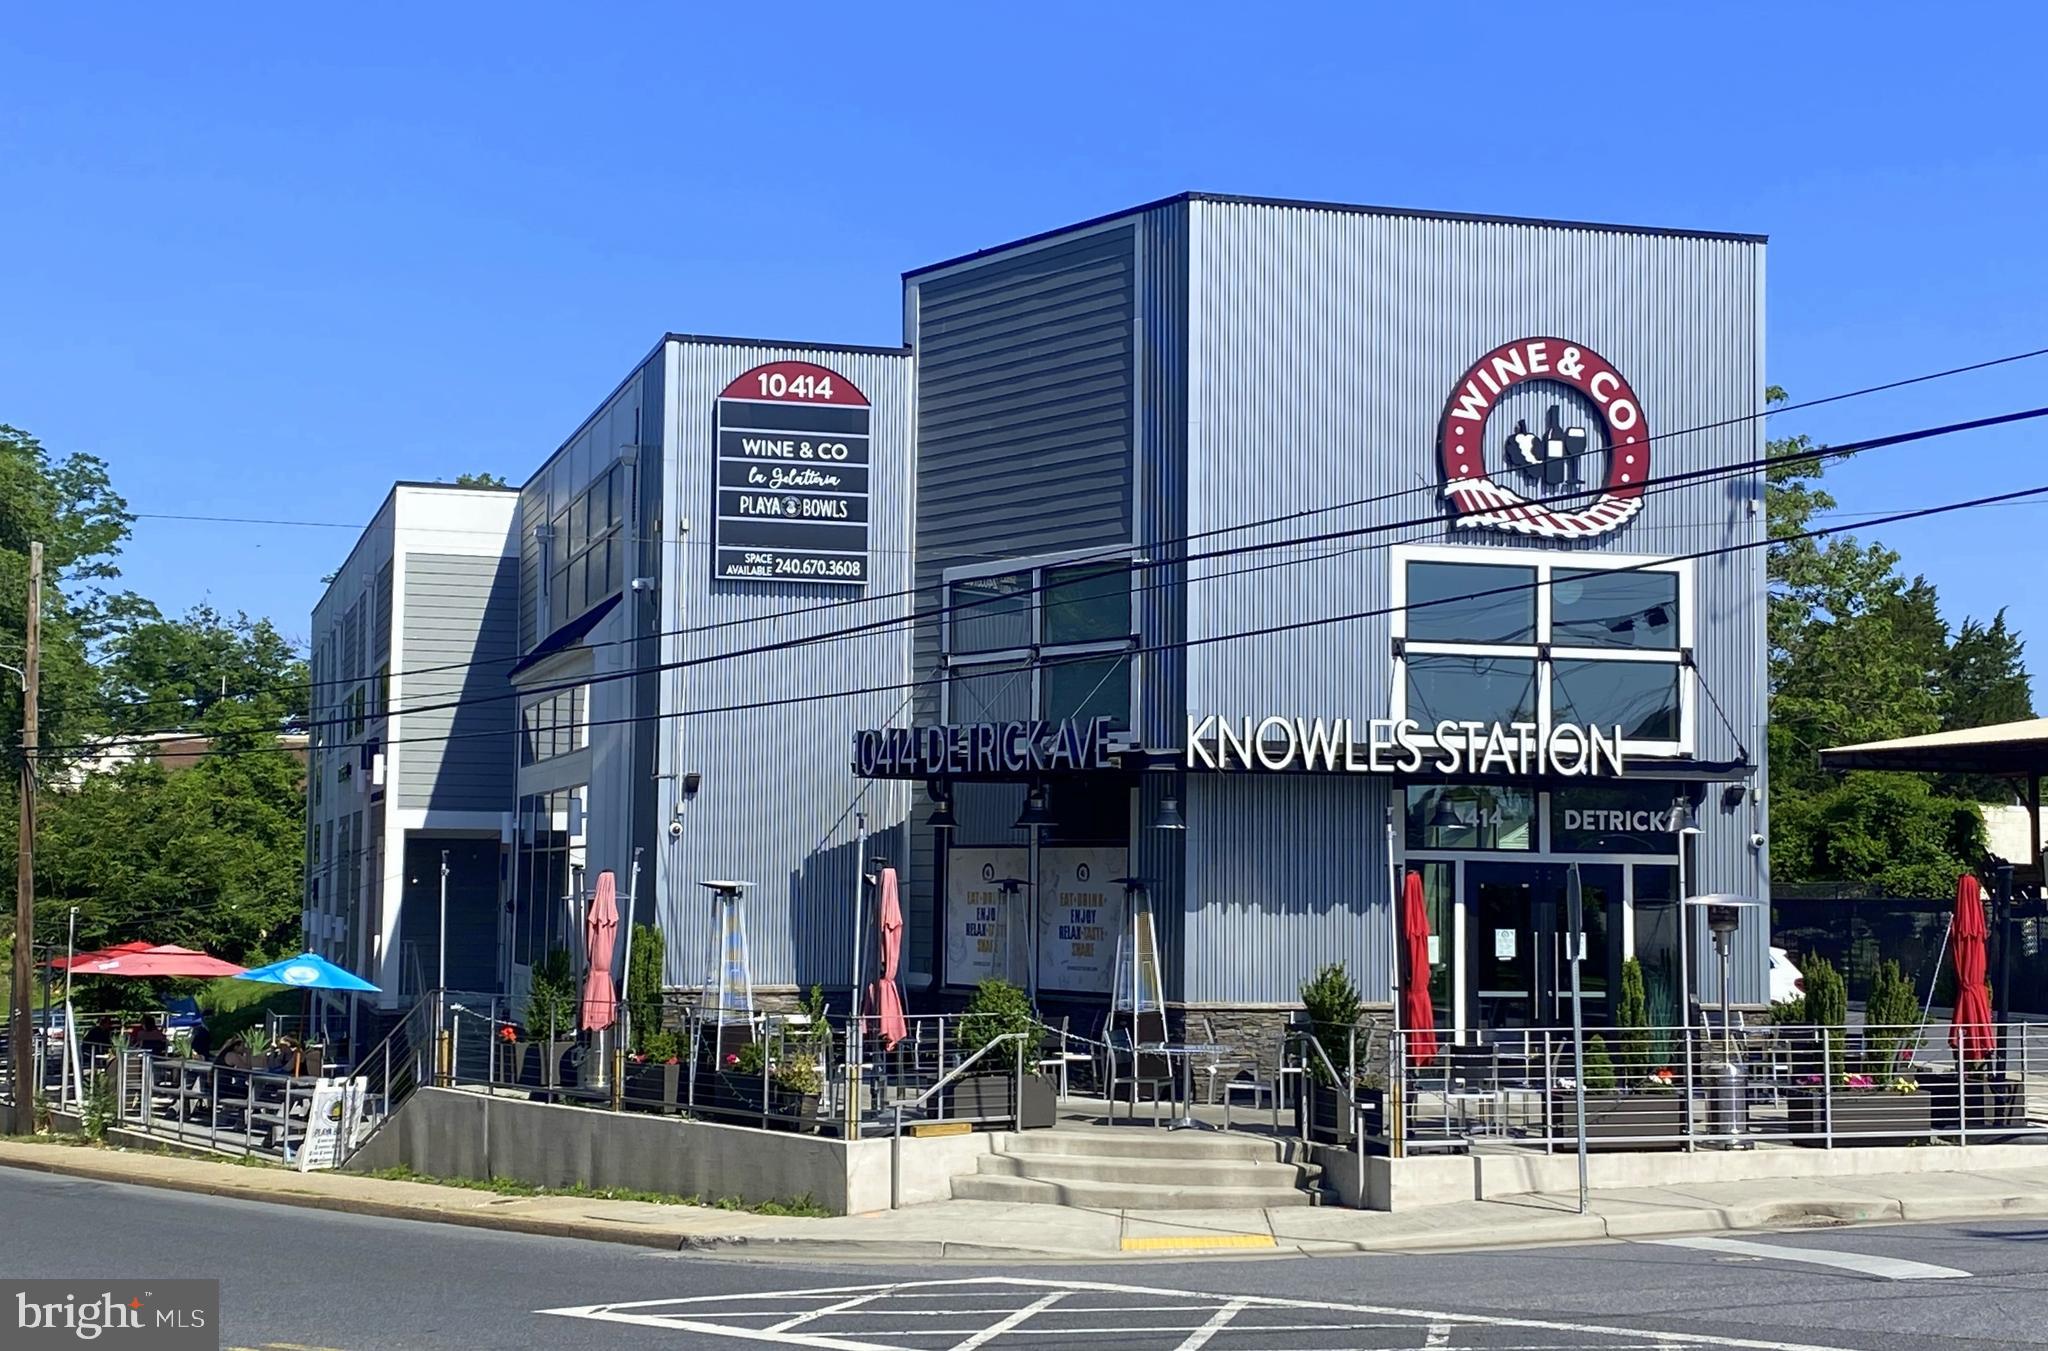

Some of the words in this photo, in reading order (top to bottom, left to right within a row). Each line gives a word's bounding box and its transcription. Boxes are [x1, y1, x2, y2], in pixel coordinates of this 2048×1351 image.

[758, 372, 834, 399] 10414
[1451, 342, 1550, 421] WINE
[1557, 347, 1586, 380] &
[1590, 371, 1637, 430] CO
[742, 438, 794, 457] WINE
[799, 441, 814, 458] &
[817, 442, 848, 460] CO
[748, 466, 767, 483] la
[740, 495, 781, 515] PLAYA
[803, 499, 848, 518] BOWLS
[726, 565, 773, 576] AVAILABLE
[745, 553, 773, 564] SPACE
[775, 558, 861, 576] 240.670.3608
[852, 731, 917, 775] 10414
[926, 718, 1046, 773] DETRICK
[1050, 716, 1112, 769] AVE
[1187, 715, 1422, 773] KNOWLES
[1436, 720, 1625, 777] STATION
[1564, 809, 1666, 831] DETRICK
[1070, 909, 1097, 924] ENJOY
[1058, 925, 1081, 940] RELAX
